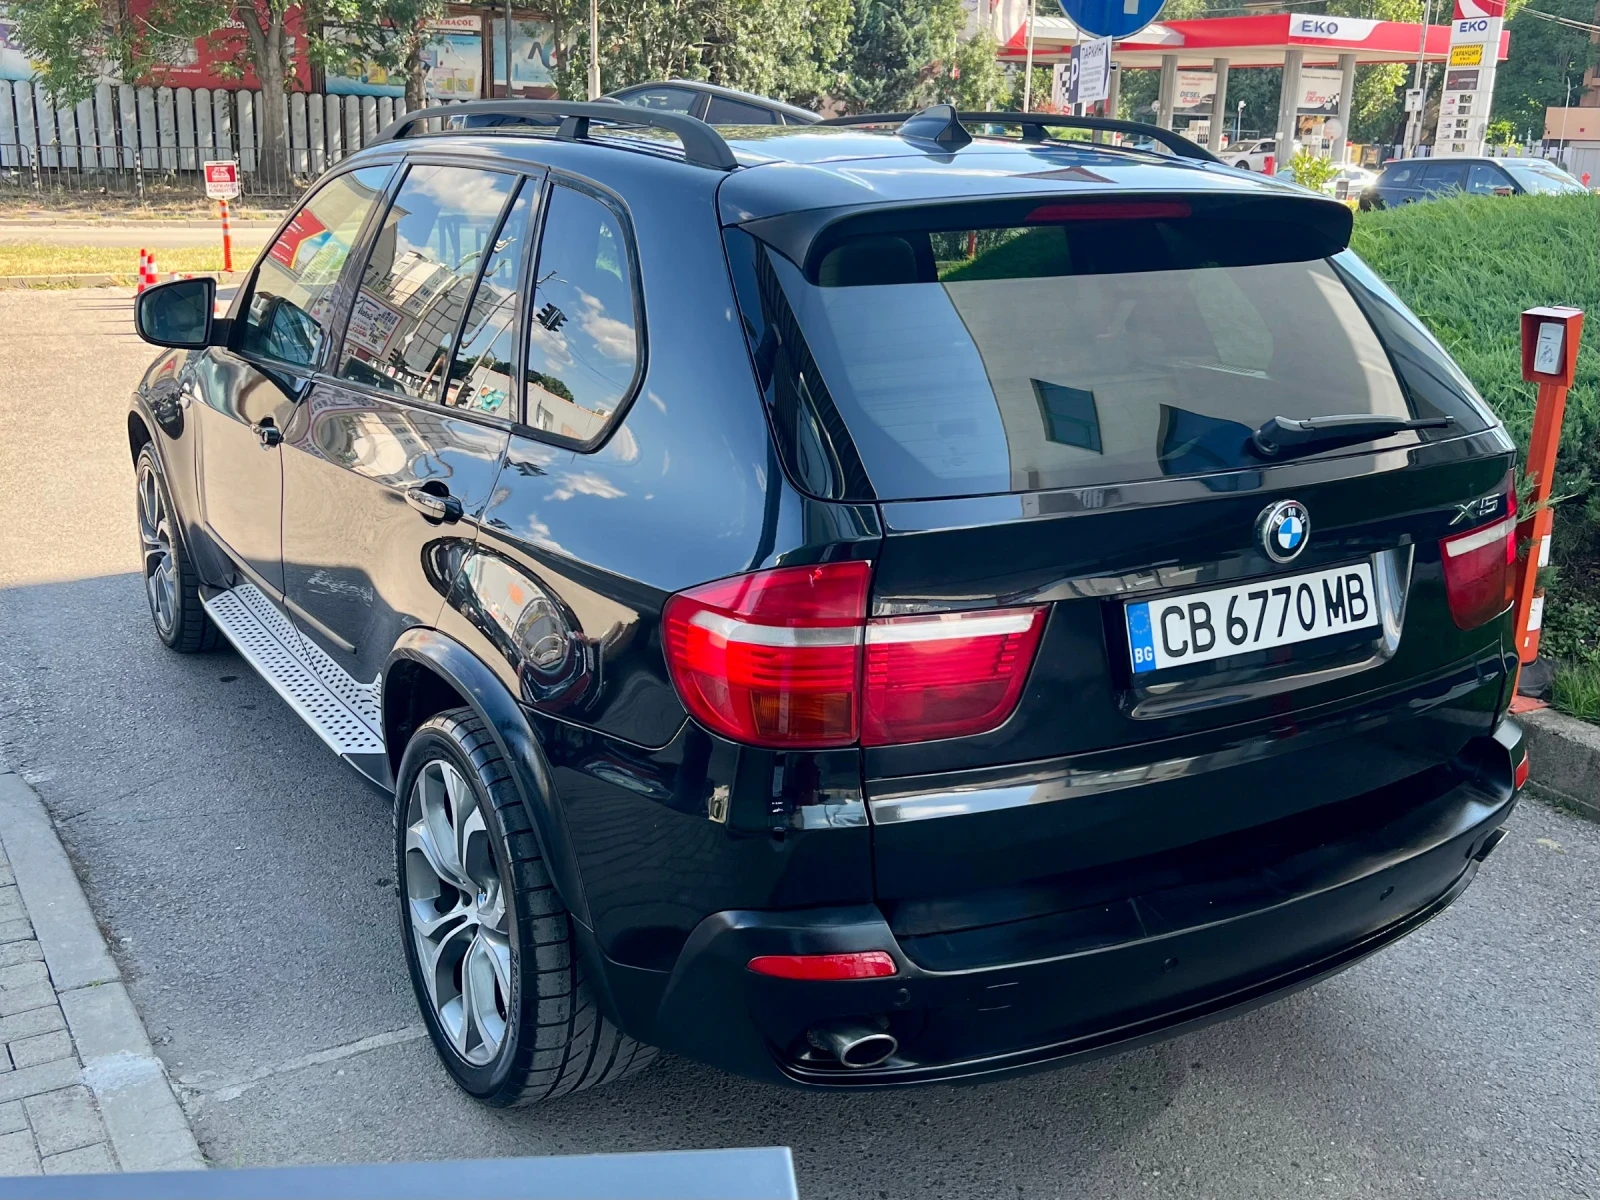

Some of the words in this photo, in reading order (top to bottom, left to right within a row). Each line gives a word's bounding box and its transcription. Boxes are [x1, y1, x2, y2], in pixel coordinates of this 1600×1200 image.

[1302, 20, 1339, 35] EKO
[1459, 20, 1488, 33] EKO
[1081, 42, 1106, 60] ПАРКИНГ
[1070, 57, 1079, 90] P
[1274, 507, 1306, 525] BMW
[1448, 492, 1500, 526] X5
[1160, 601, 1217, 658] CB
[1226, 582, 1317, 646] 6770
[1322, 572, 1369, 628] MB
[1134, 646, 1154, 664] BG
